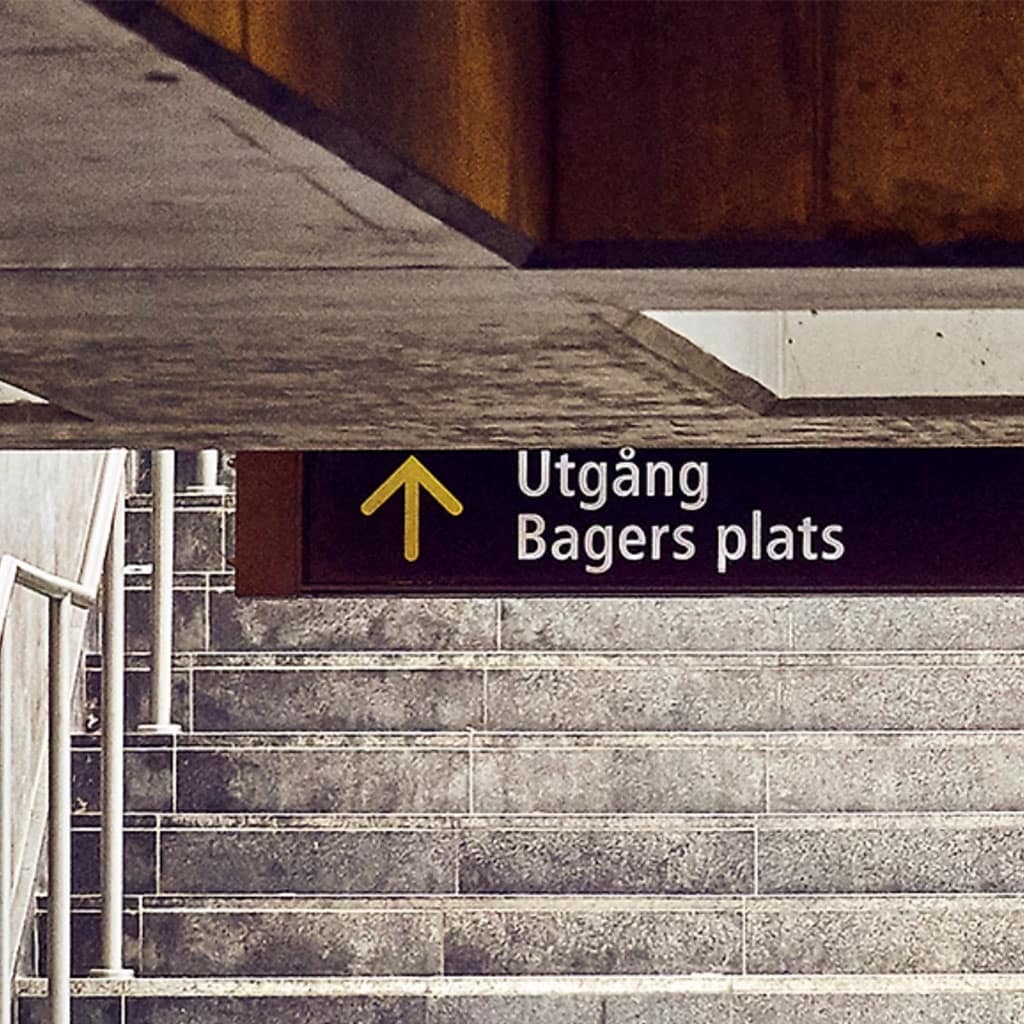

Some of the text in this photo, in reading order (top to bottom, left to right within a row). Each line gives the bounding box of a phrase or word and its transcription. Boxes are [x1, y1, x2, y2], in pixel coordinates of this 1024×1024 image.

[517, 447, 709, 511] Utgång
[517, 509, 846, 574] Bagers plats
